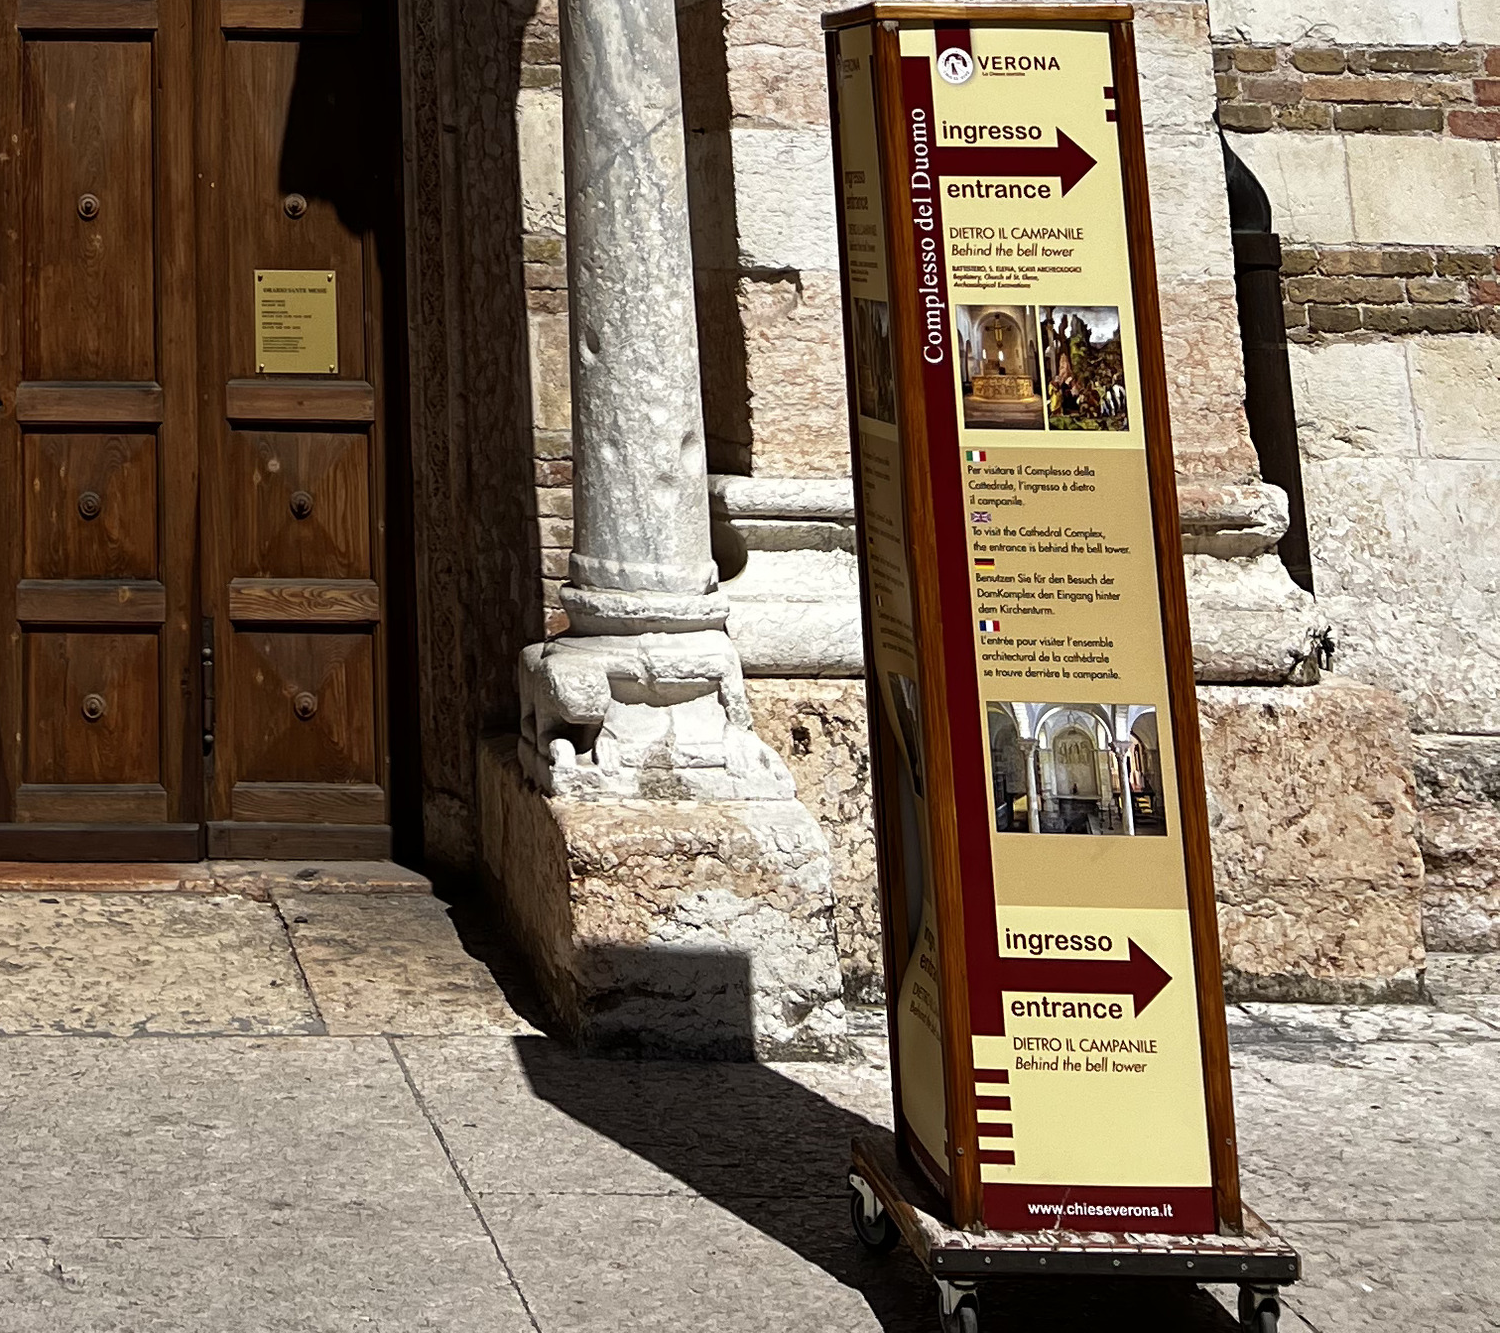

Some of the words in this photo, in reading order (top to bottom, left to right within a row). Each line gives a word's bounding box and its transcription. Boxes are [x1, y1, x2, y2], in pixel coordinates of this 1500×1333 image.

[978, 56, 1060, 71] VERONA
[942, 121, 1042, 143] ingresso
[911, 108, 931, 190] Duomo
[947, 180, 1051, 199] entrance
[912, 197, 934, 231] del
[950, 227, 994, 239] DIETRO
[999, 227, 1008, 239] IL
[1011, 227, 1084, 240] CAMPANILE
[952, 243, 991, 256] Behind
[996, 245, 1013, 256] the
[1017, 244, 1038, 257] bell
[1042, 247, 1074, 257] tower
[918, 237, 945, 364] Complesso
[968, 465, 981, 475] Per
[984, 465, 1014, 475] visitare
[1017, 465, 1022, 475] il
[1025, 465, 1072, 478] Complesso
[1074, 466, 1095, 477] della
[968, 480, 1016, 491] Cattedrale,
[1018, 480, 1060, 493] l'ingresso
[1070, 481, 1095, 491] dietro
[970, 495, 975, 505] il
[978, 495, 1025, 508] campanile.
[972, 526, 982, 536] To
[984, 527, 1001, 537] visit
[1004, 526, 1016, 537] the
[1019, 527, 1062, 537] Cathedral
[1064, 527, 1106, 540] Complex,
[974, 541, 986, 551] the
[990, 542, 1026, 552] entrance
[1029, 543, 1036, 552] is
[1038, 542, 1068, 553] behind
[1071, 543, 1084, 553] the
[1087, 543, 1102, 553] bell
[1105, 545, 1131, 554] tower.
[976, 573, 1016, 583] Benutzen
[1018, 573, 1031, 583] Sie
[1034, 573, 1046, 583] für
[1049, 573, 1065, 584] den
[1067, 574, 1098, 585] Besuch
[1100, 574, 1115, 585] der
[1038, 589, 1054, 599] den
[1057, 589, 1094, 603] Eingang
[1095, 589, 1120, 601] hinter
[978, 603, 997, 613] dem
[1000, 604, 1055, 615] Kirchenturm.
[1017, 637, 1037, 648] pour
[1040, 637, 1065, 647] visiter
[1067, 635, 1114, 647] l'ensemble
[982, 650, 1036, 661] architectural
[1039, 651, 1050, 662] de
[1052, 651, 1061, 662] la
[1063, 652, 1110, 663] cathédrale
[984, 669, 993, 677] se
[996, 669, 1022, 677] trouve
[1025, 667, 1060, 678] derrière
[1062, 667, 1070, 678] le
[1006, 929, 1112, 955] ingresso
[1011, 997, 1123, 1019] entrance
[1013, 1037, 1062, 1051] DIETRO
[1066, 1038, 1076, 1052] IL
[1079, 1039, 1158, 1053] CAMPANILE
[1016, 1057, 1058, 1071] Behind
[1063, 1058, 1081, 1071] the
[1086, 1057, 1107, 1072] bell
[1112, 1060, 1148, 1073] tower
[1028, 1202, 1173, 1217] www.chieseverona.it
